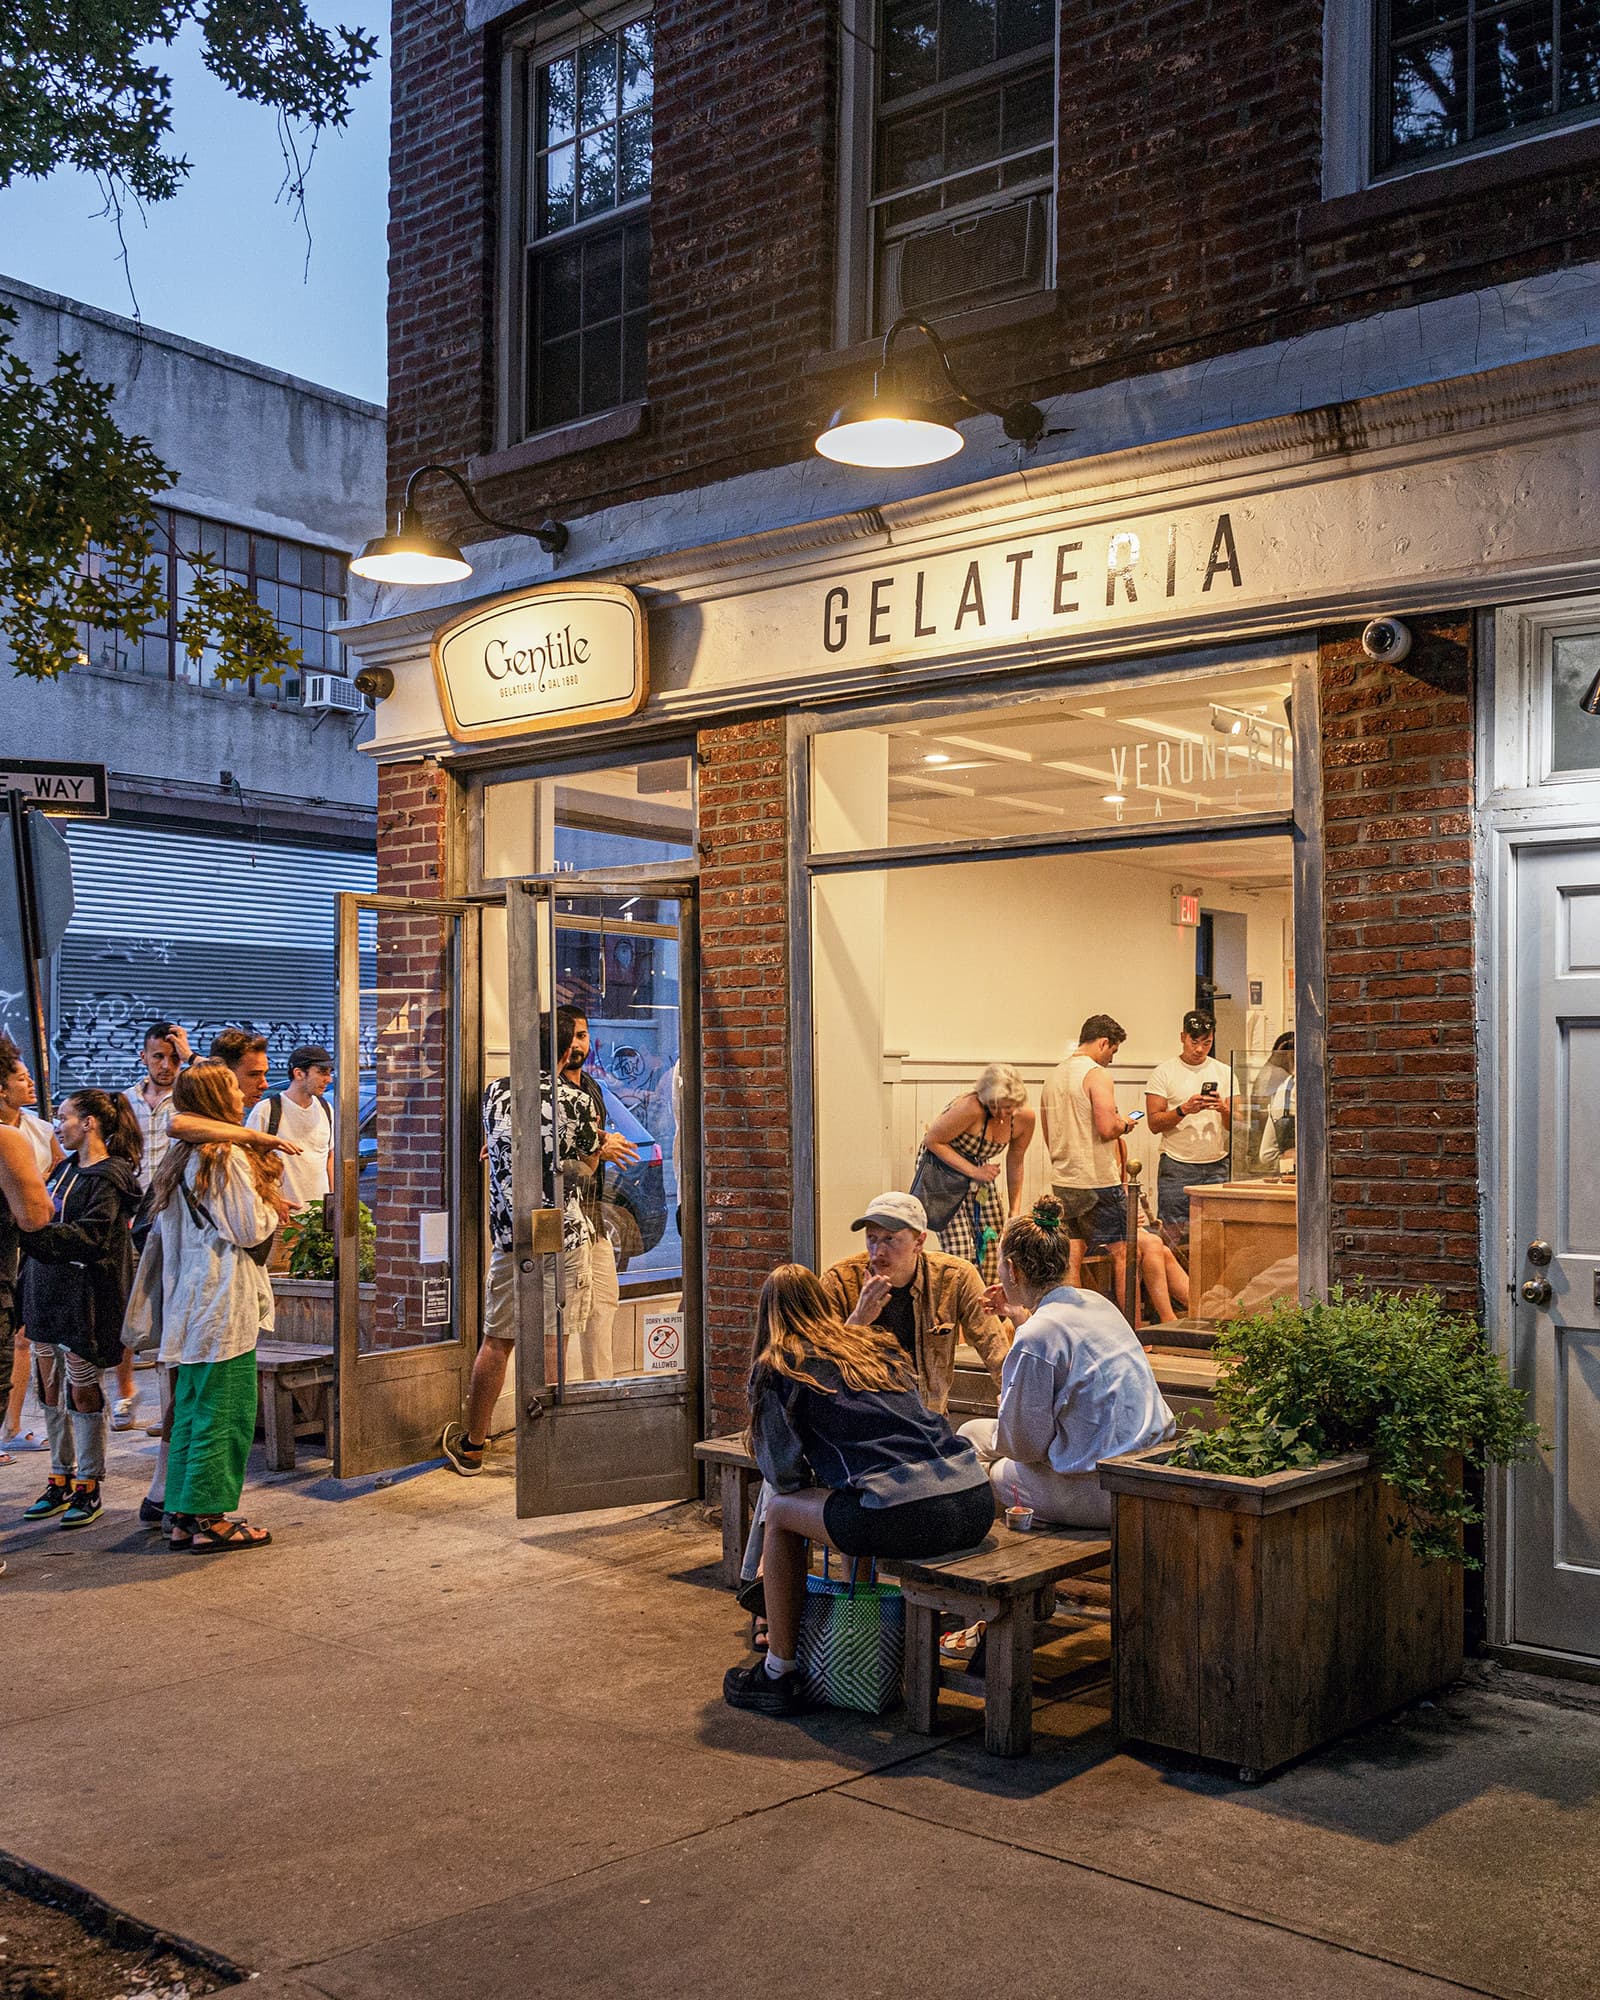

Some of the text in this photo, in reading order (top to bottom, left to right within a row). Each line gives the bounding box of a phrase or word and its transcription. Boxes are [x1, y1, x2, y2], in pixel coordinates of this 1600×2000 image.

[824, 513, 1242, 653] GELATERIA
[484, 624, 591, 692] Gentile
[499, 682, 536, 698] GELATIERI
[547, 678, 561, 689] DAL
[1111, 727, 1286, 792] VERONERO
[34, 776, 84, 799] WAY
[1181, 895, 1198, 924] EXIT
